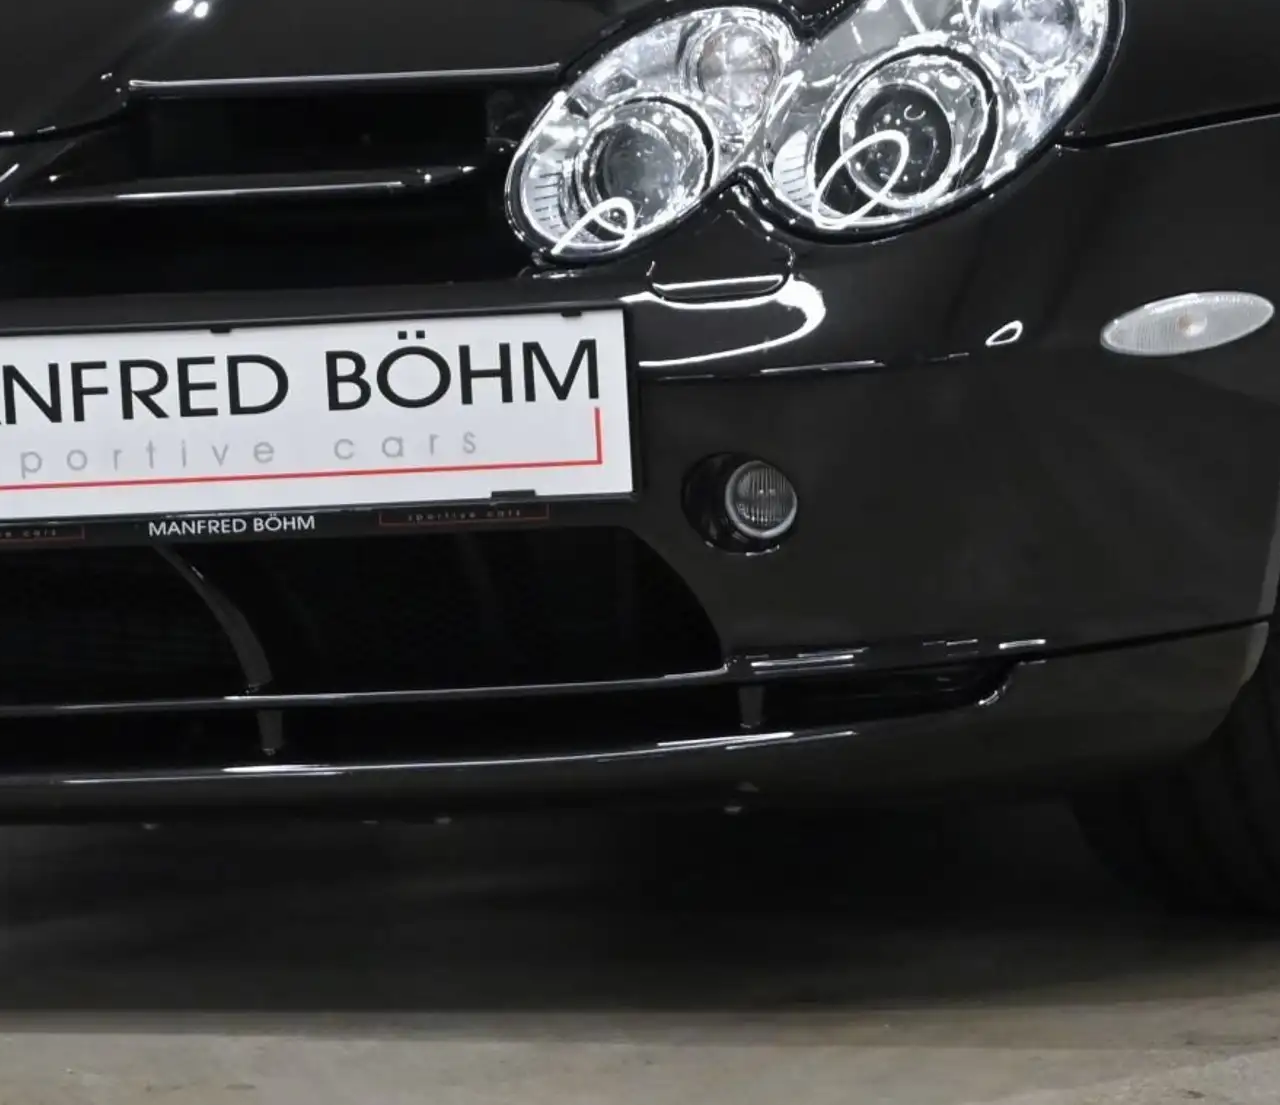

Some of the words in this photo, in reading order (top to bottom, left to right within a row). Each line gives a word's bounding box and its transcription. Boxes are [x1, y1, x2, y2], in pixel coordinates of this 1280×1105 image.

[326, 330, 599, 411] BÖHM
[333, 429, 477, 463] cars
[148, 518, 247, 537] MANFRED
[253, 512, 316, 532] BÖHM
